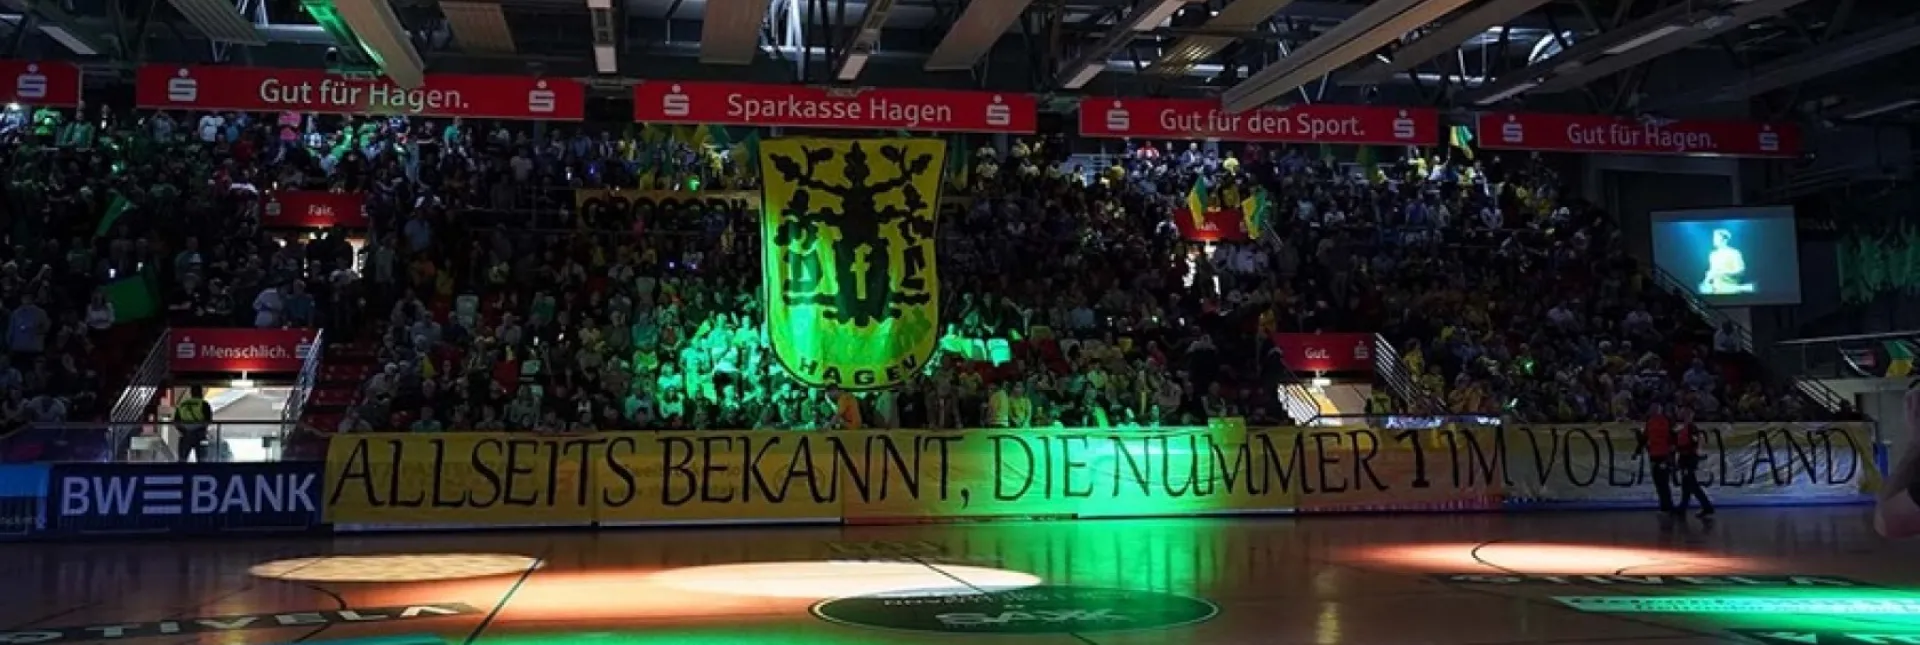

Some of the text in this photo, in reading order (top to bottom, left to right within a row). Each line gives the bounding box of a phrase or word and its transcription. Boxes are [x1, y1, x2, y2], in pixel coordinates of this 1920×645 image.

[260, 78, 469, 113] Gut für Hagen.
[727, 92, 951, 127] Sparkasse Hagen
[1160, 108, 1366, 140] Gut für den Sport.
[1567, 123, 1717, 151] Gut für Hagen.
[201, 345, 290, 359] Menschlich.
[1304, 346, 1331, 359] Gut.
[799, 354, 917, 385] HAGEN
[329, 436, 636, 509] ALLSEITS
[656, 434, 969, 508] BEKANNT,
[988, 433, 1093, 501] DIE
[1107, 432, 1388, 498] NUMMER
[1395, 428, 1429, 488] 1
[1446, 426, 1514, 488] IM
[190, 472, 317, 514] BANK
